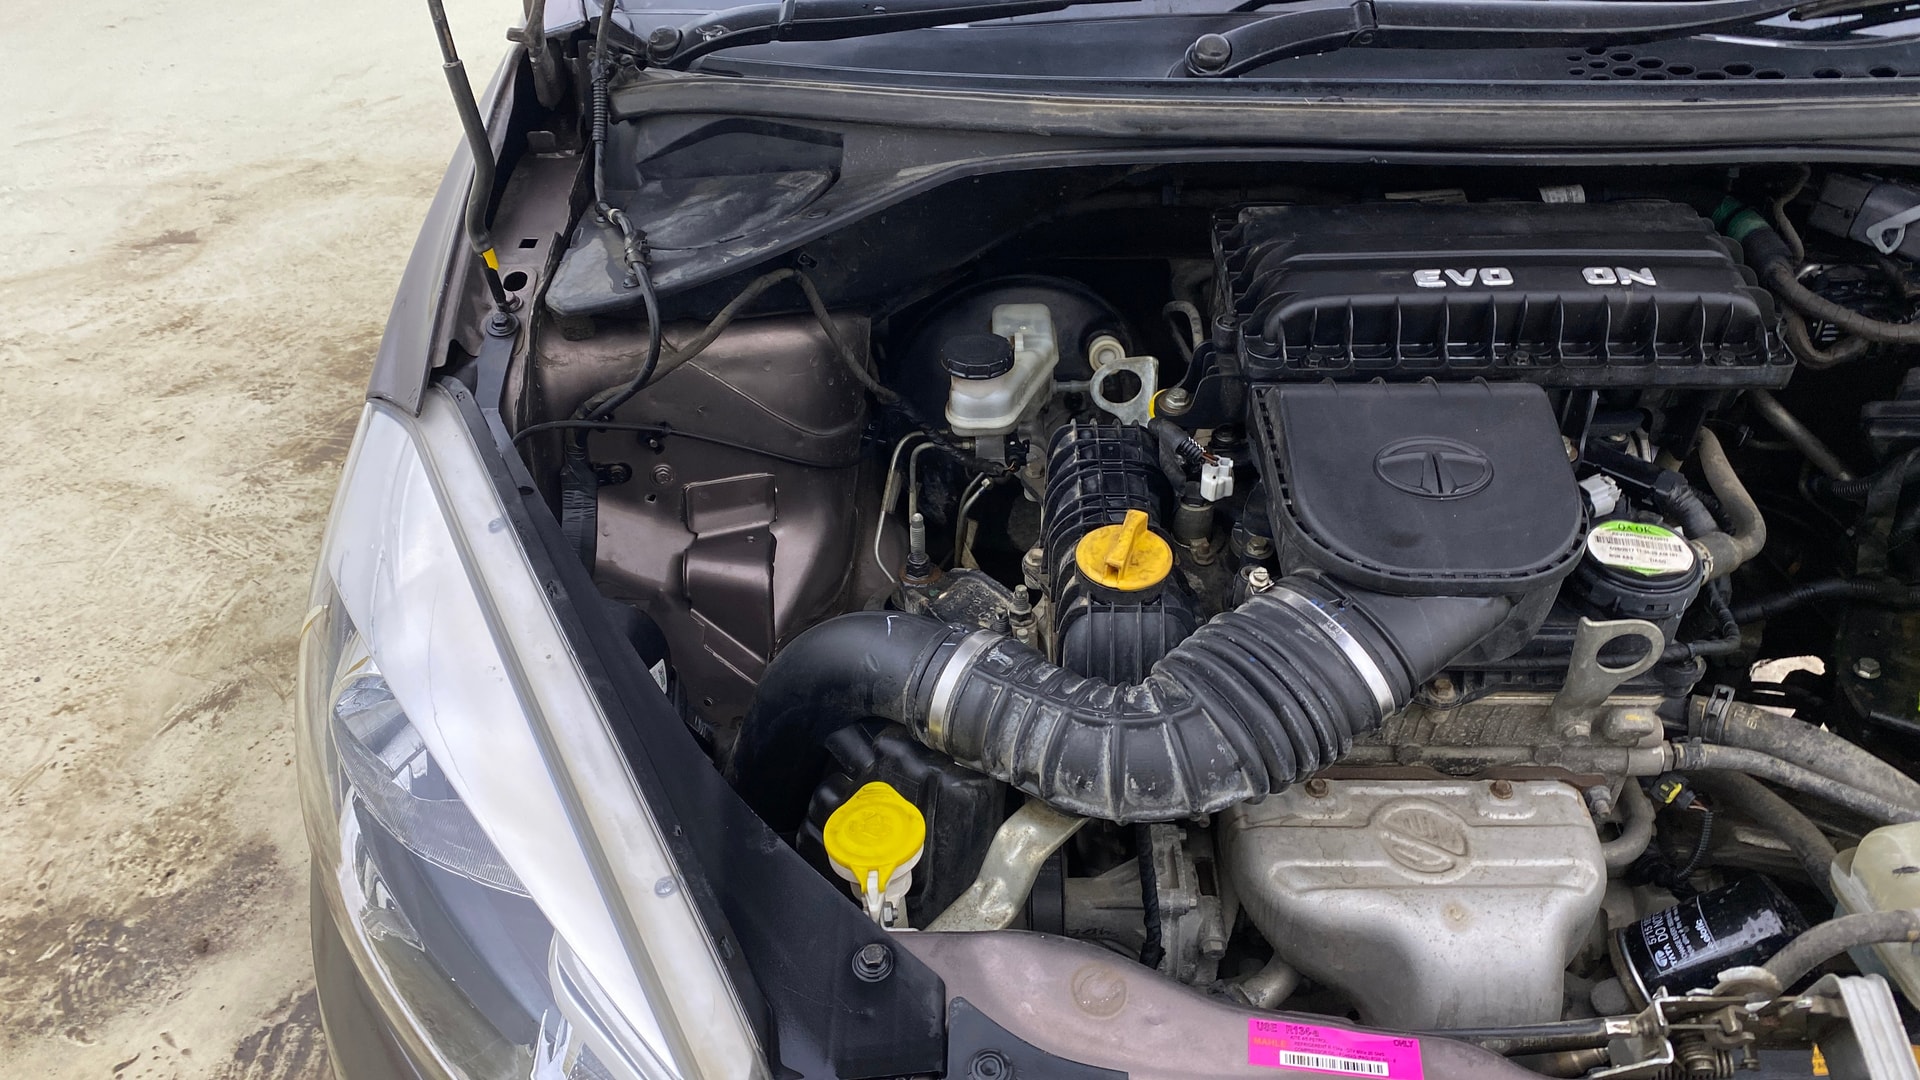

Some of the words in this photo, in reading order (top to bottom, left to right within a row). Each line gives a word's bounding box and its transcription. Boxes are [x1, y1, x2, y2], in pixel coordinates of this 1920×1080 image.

[1412, 267, 1514, 288] EVO
[1581, 267, 1657, 286] ON
[1636, 525, 1651, 533] OK
[1655, 926, 1669, 943] DO
[1663, 942, 1678, 968] TATA
[1254, 1037, 1287, 1047] MAHLE
[1256, 1021, 1278, 1033] USE
[1393, 1039, 1414, 1048] ONLY
